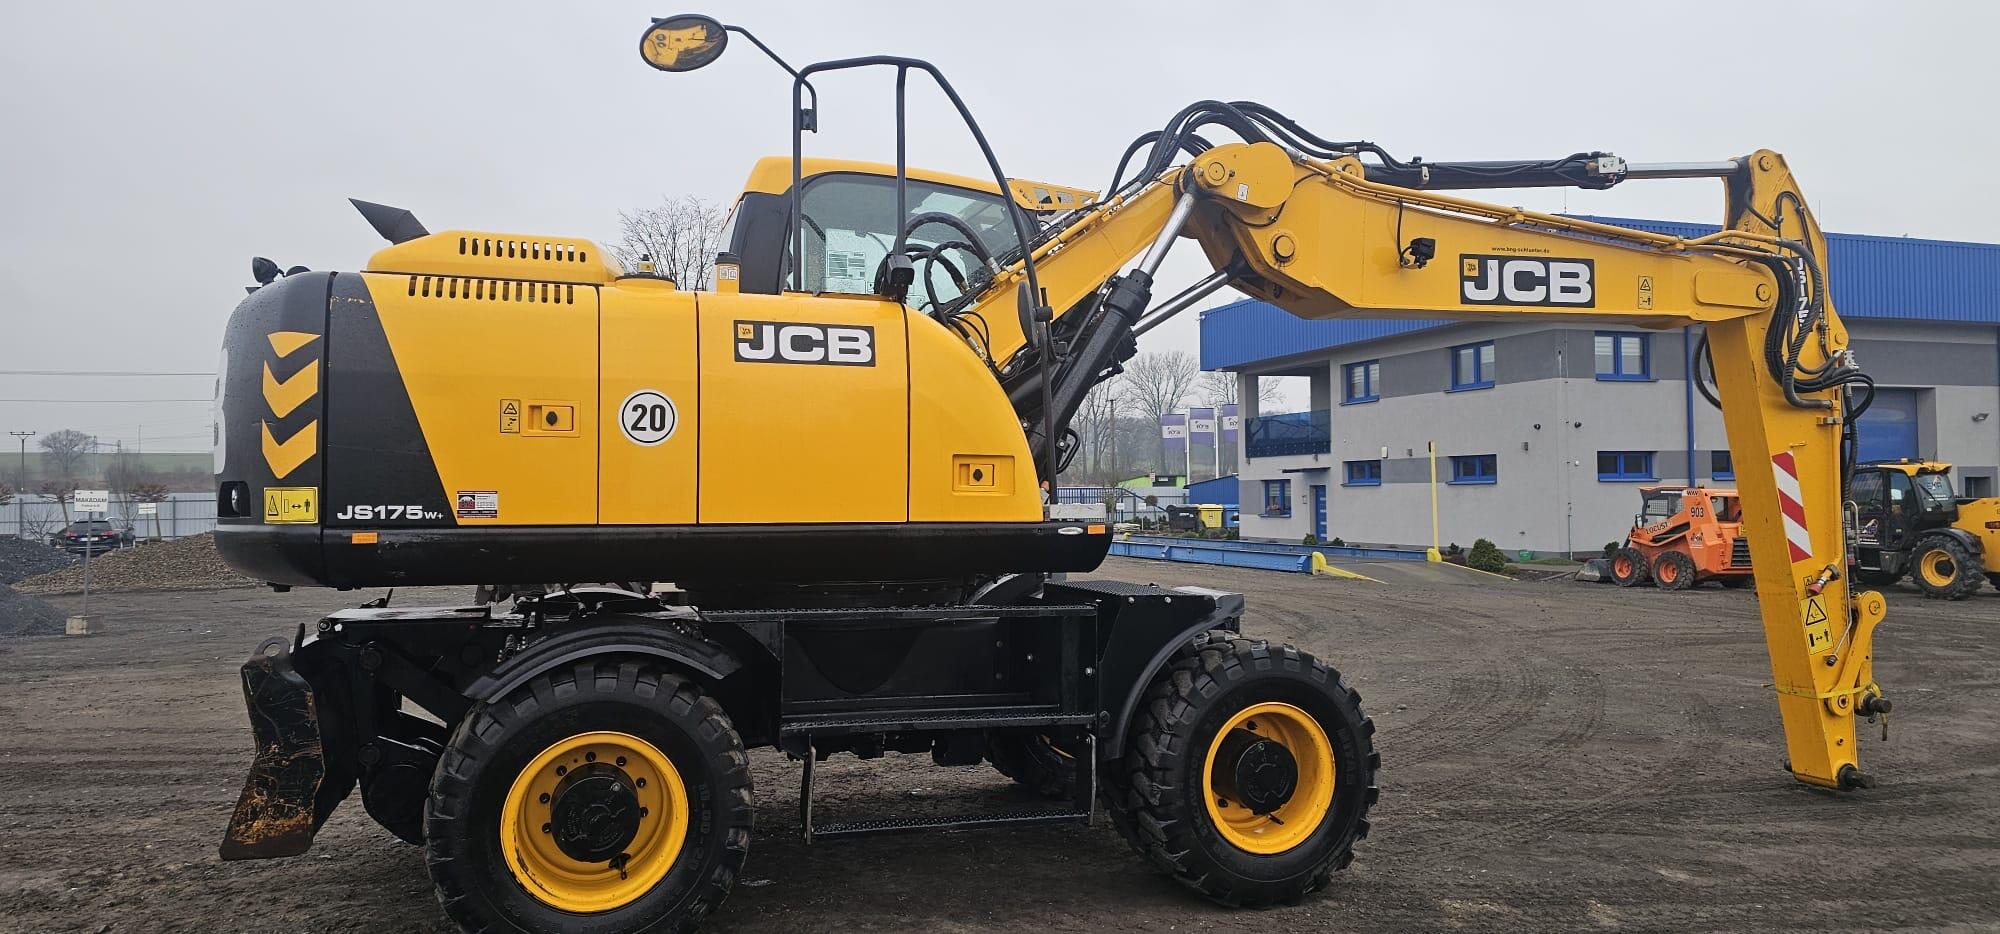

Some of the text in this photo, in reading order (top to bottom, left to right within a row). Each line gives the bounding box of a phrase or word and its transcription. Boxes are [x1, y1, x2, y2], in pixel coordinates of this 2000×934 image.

[1463, 259, 1592, 303] JCB
[737, 325, 873, 363] JCB
[630, 403, 667, 432] 20
[1690, 507, 1704, 518] 903
[1646, 522, 1668, 535] LOCUST
